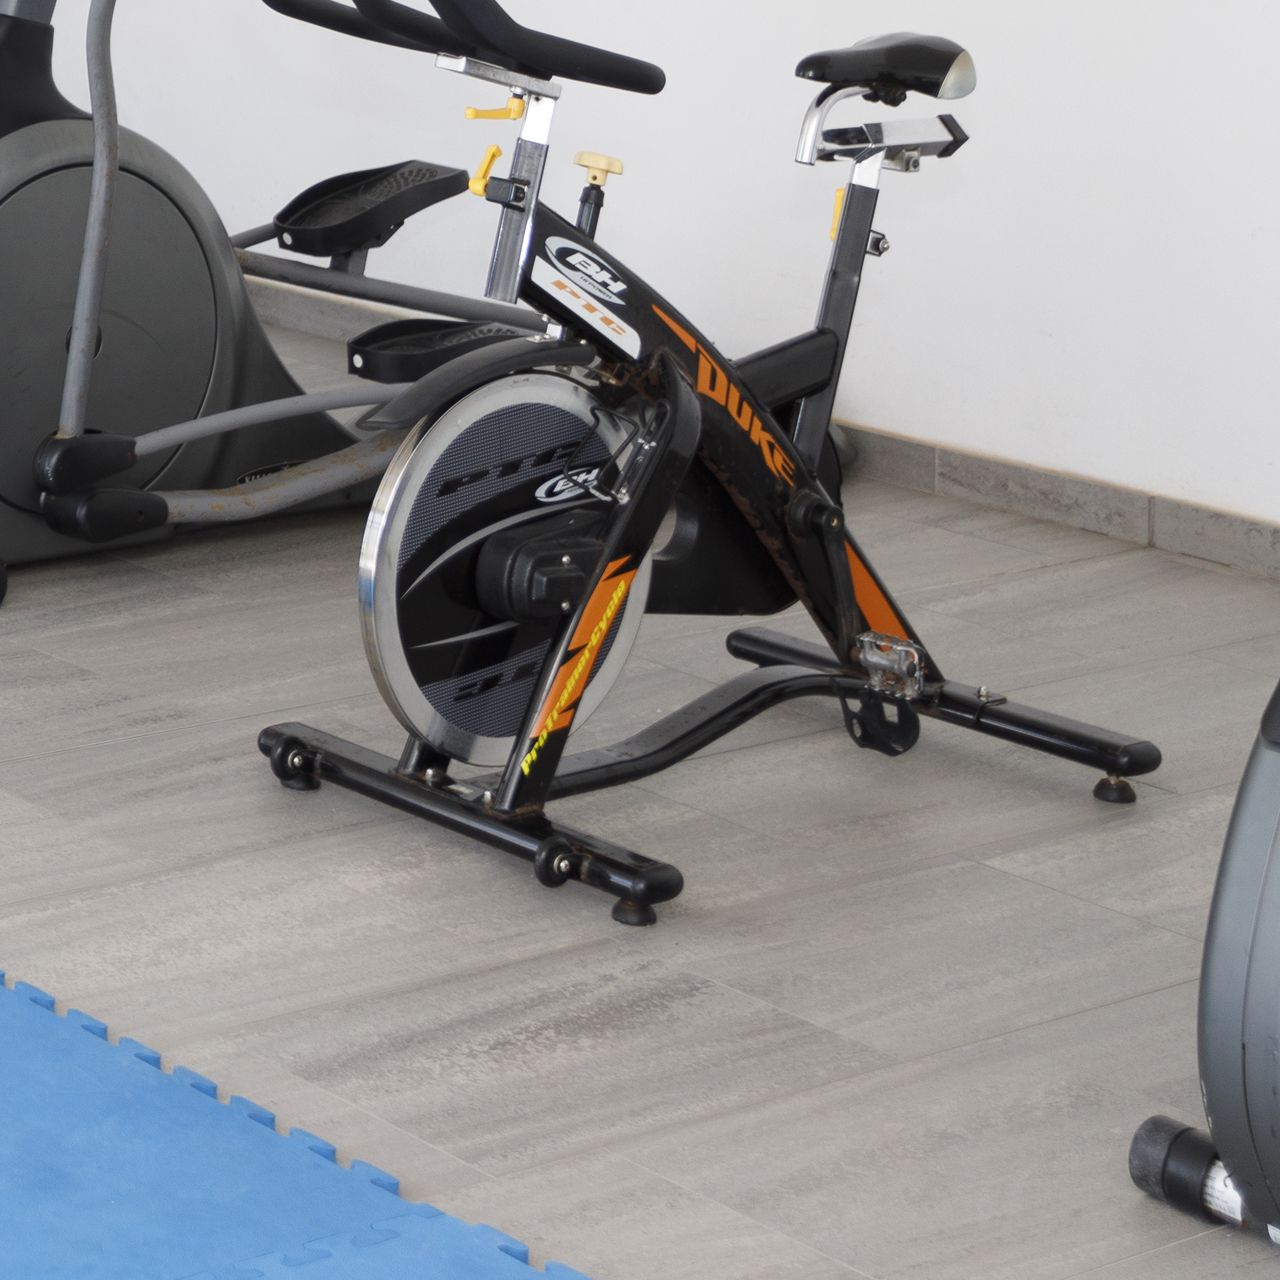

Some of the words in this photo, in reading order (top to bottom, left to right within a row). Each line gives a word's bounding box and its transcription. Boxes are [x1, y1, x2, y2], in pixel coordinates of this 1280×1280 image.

[565, 251, 627, 293] BH
[552, 280, 626, 335] PTC
[696, 342, 797, 487] DUKE
